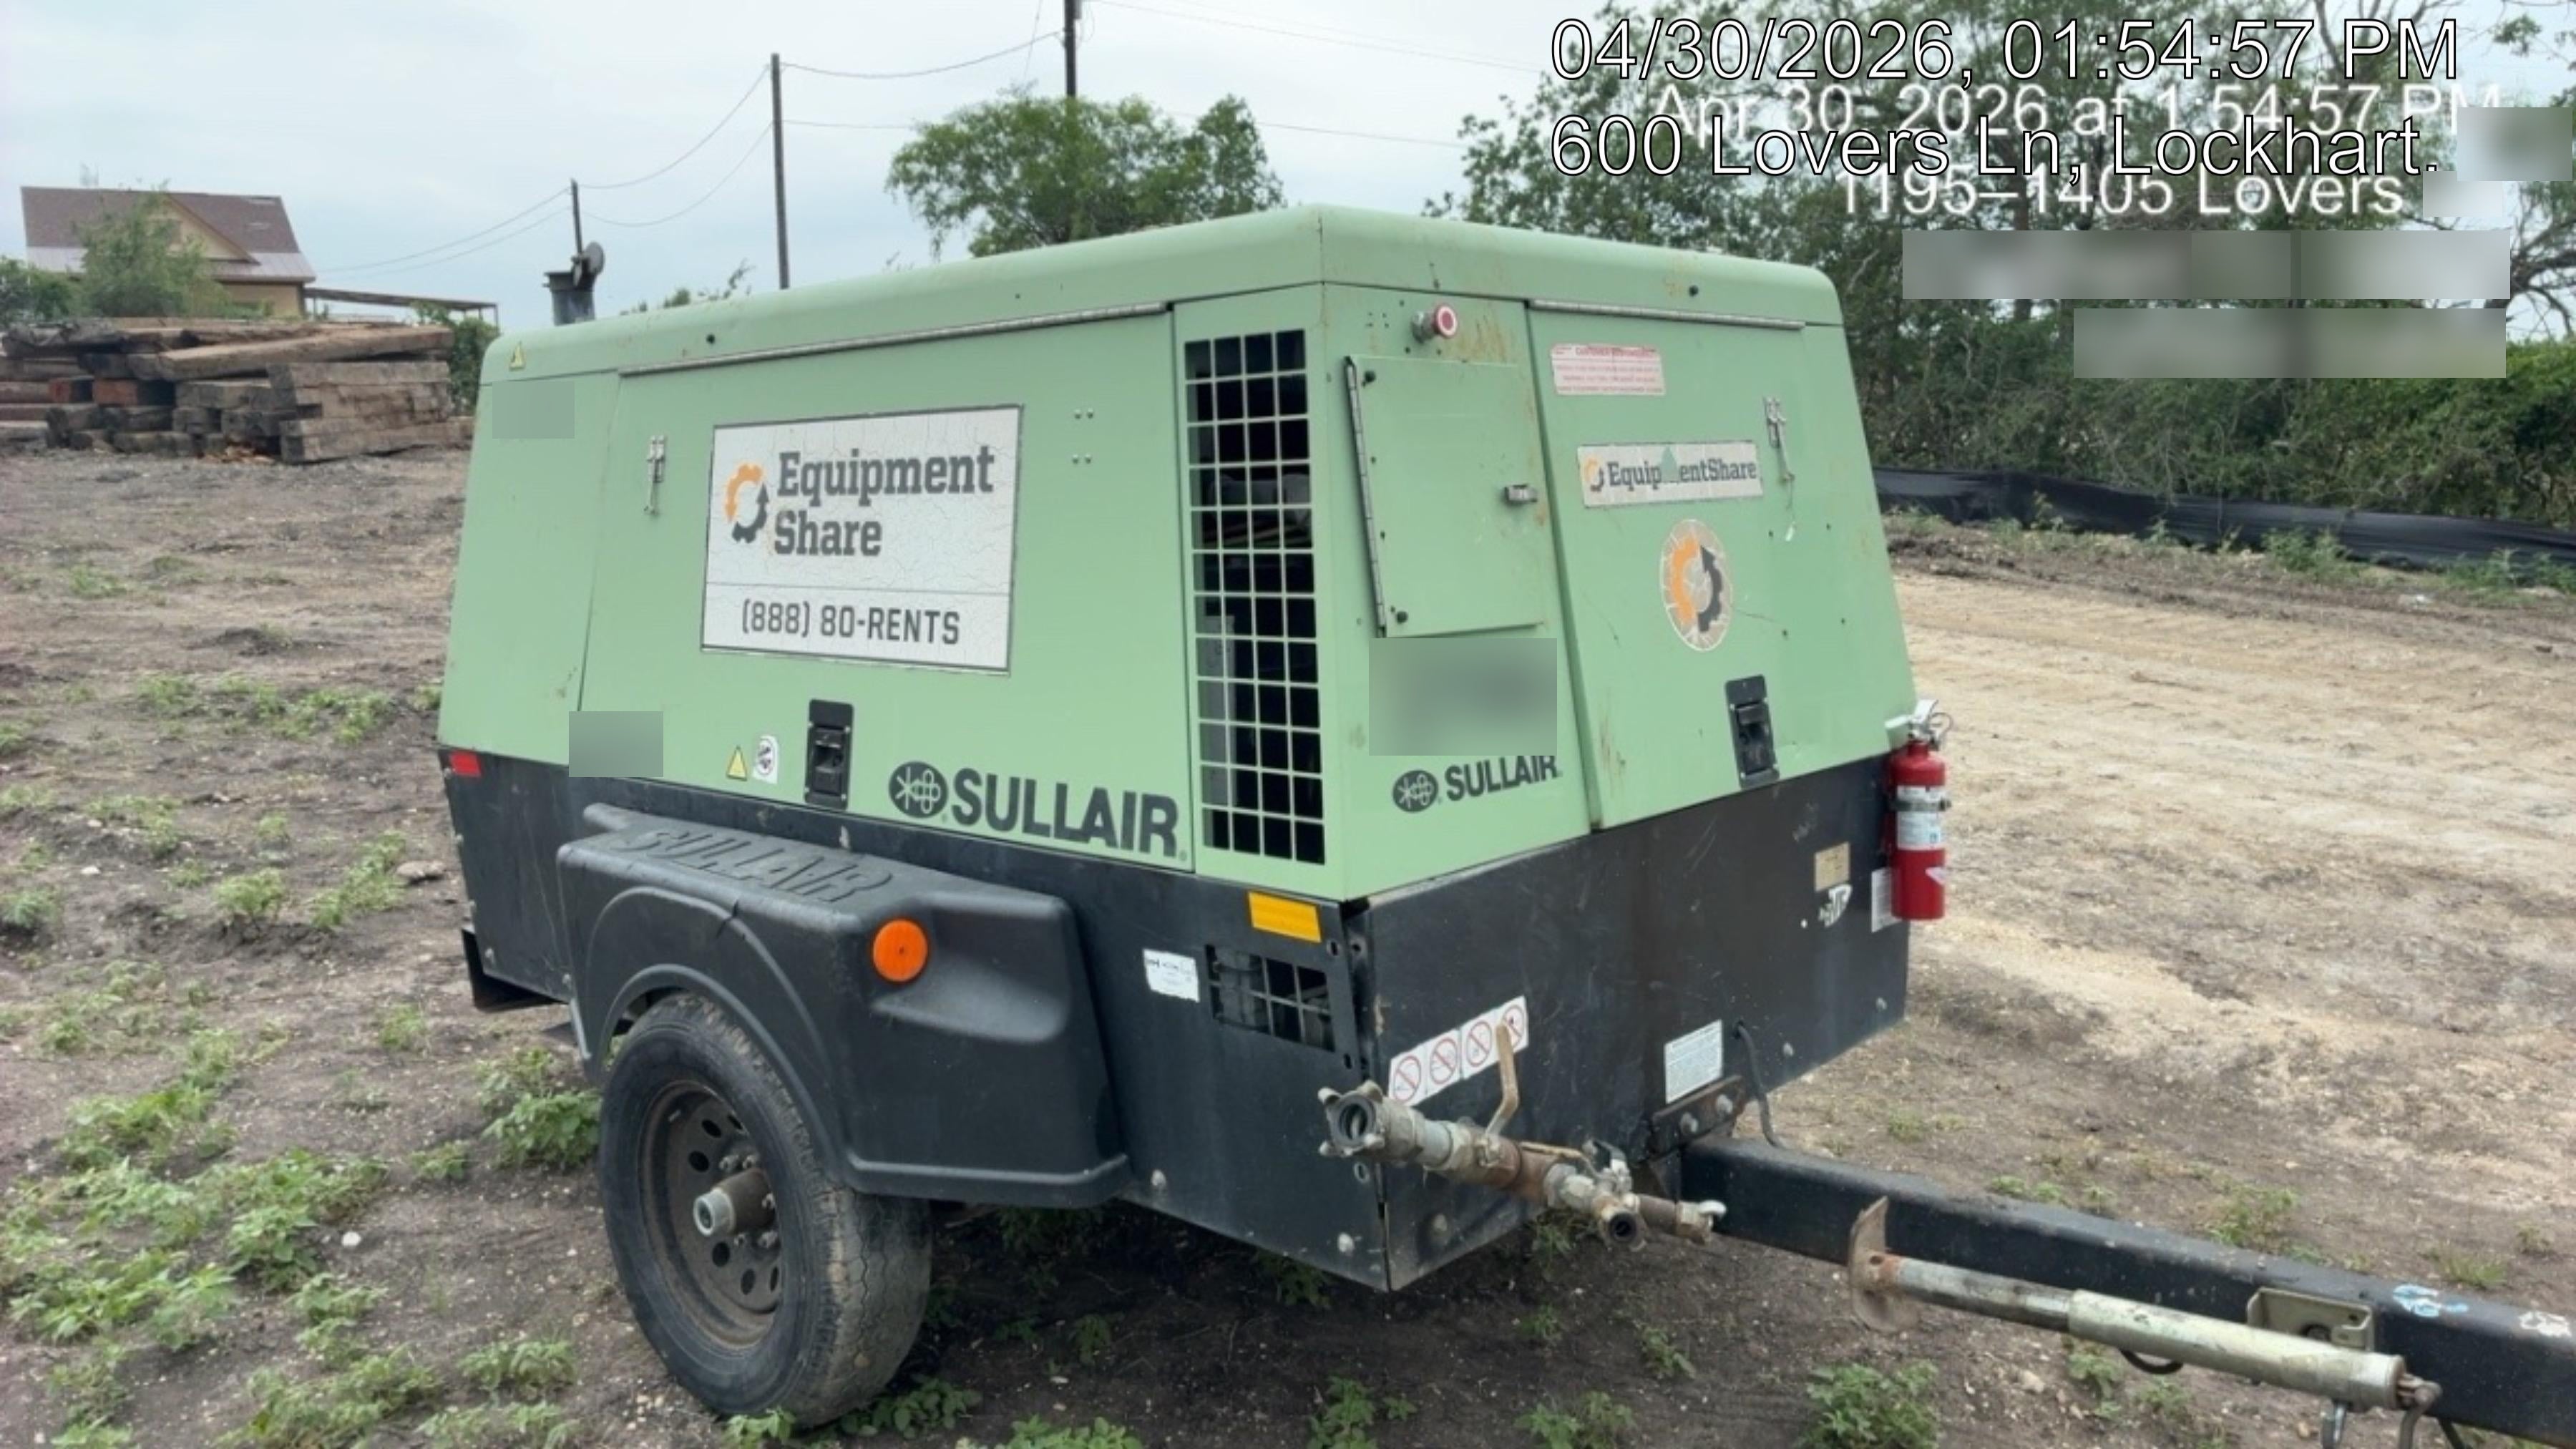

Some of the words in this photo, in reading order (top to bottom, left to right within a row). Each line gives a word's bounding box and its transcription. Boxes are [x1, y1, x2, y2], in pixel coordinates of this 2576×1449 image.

[777, 445, 995, 507] Equipment
[1607, 459, 1757, 492] EquipentShare
[774, 509, 882, 556] Share
[742, 598, 810, 638] (888)
[821, 605, 960, 645] 80-RENTS
[1444, 756, 1558, 801] SULLAIR
[950, 768, 1179, 857] SULLAIR
